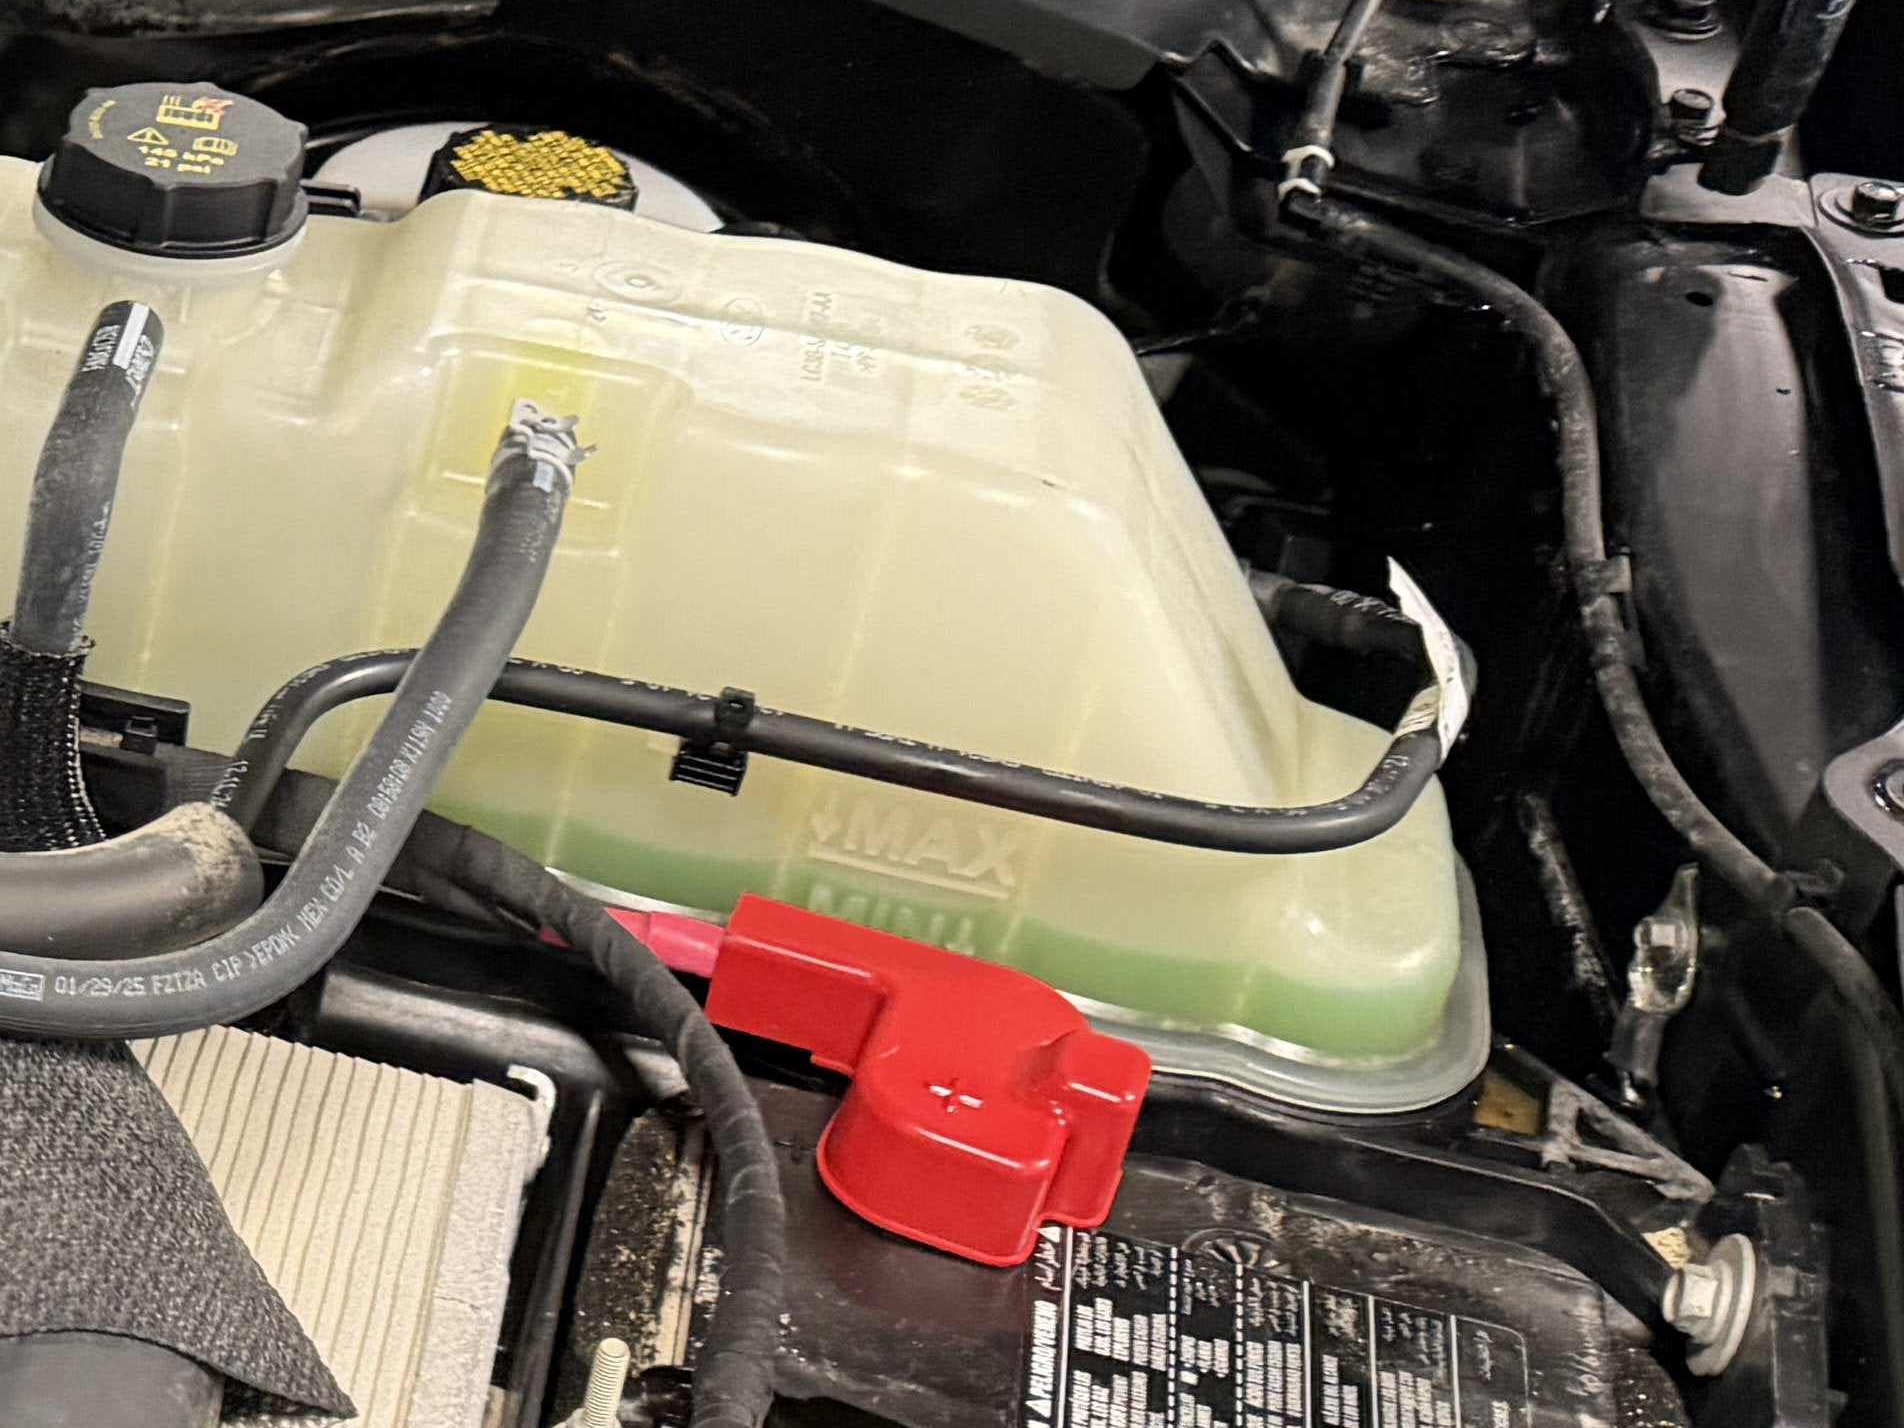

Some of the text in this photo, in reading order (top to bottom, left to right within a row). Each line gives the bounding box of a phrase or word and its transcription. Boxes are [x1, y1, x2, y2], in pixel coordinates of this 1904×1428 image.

[842, 800, 1016, 888] MAX
[297, 897, 330, 932] MEX
[350, 845, 367, 865] A
[1030, 1300, 1057, 1398] PELIGRO/VENENO
